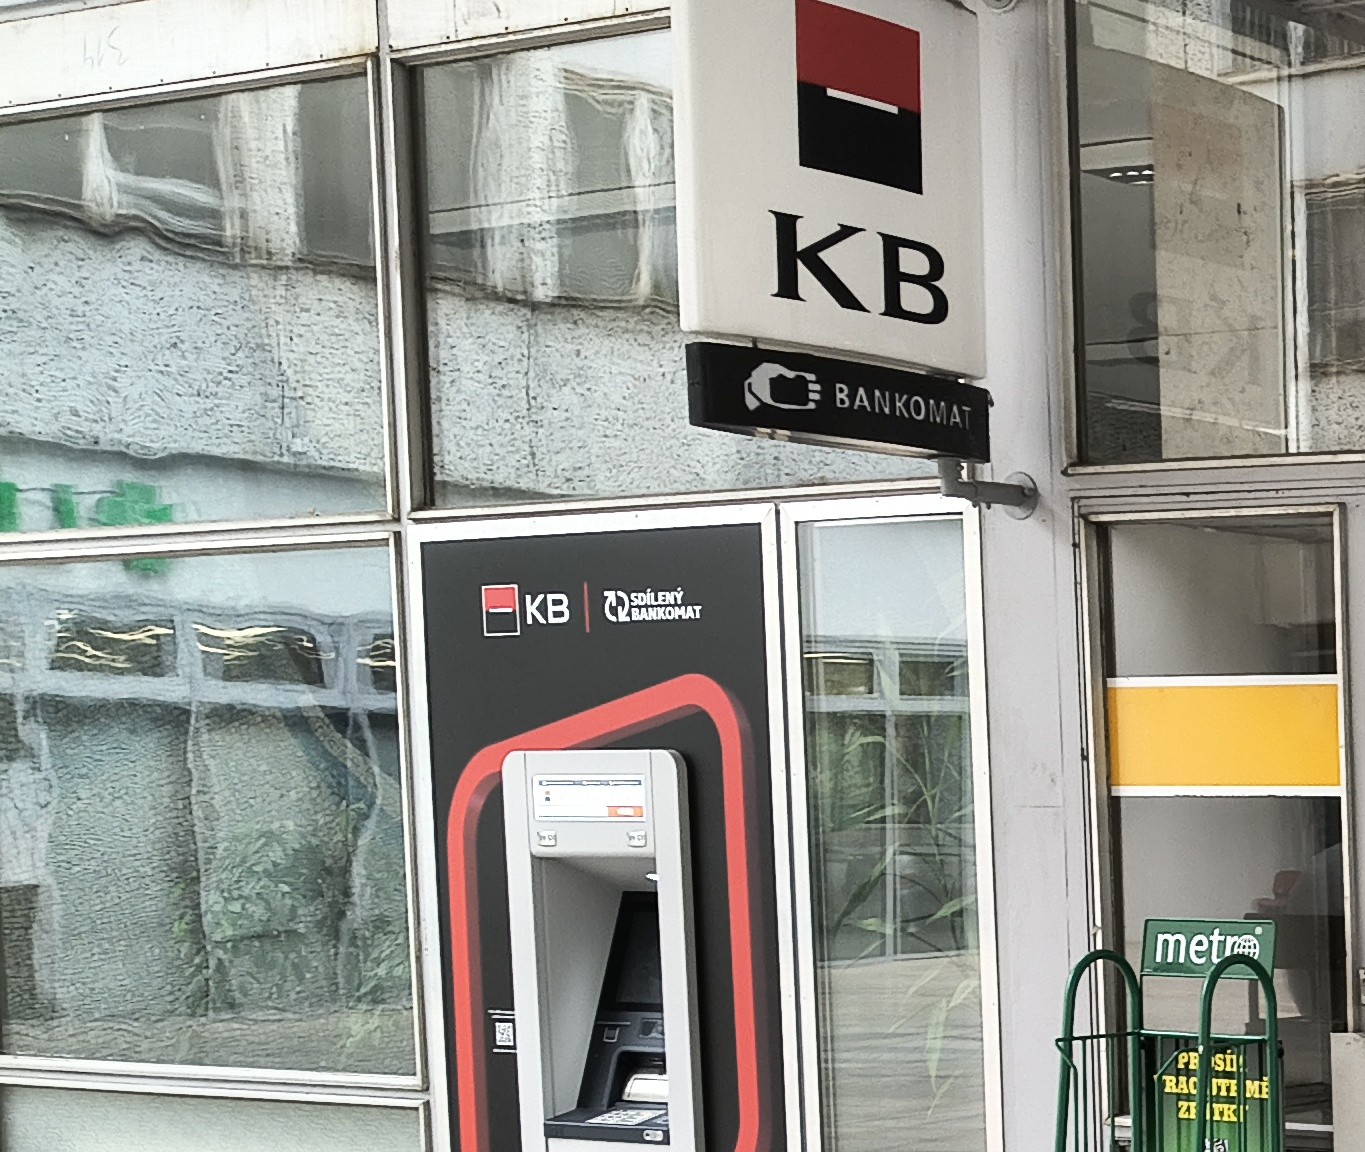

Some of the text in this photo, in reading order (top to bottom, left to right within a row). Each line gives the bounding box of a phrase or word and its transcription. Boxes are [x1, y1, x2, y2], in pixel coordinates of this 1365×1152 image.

[767, 209, 950, 326] KB
[834, 382, 972, 431] BANKOMAT
[524, 593, 571, 626] KB
[630, 587, 685, 607] SDÍLENÝ
[631, 605, 703, 622] BANKOMAT
[1155, 927, 1260, 965] metro
